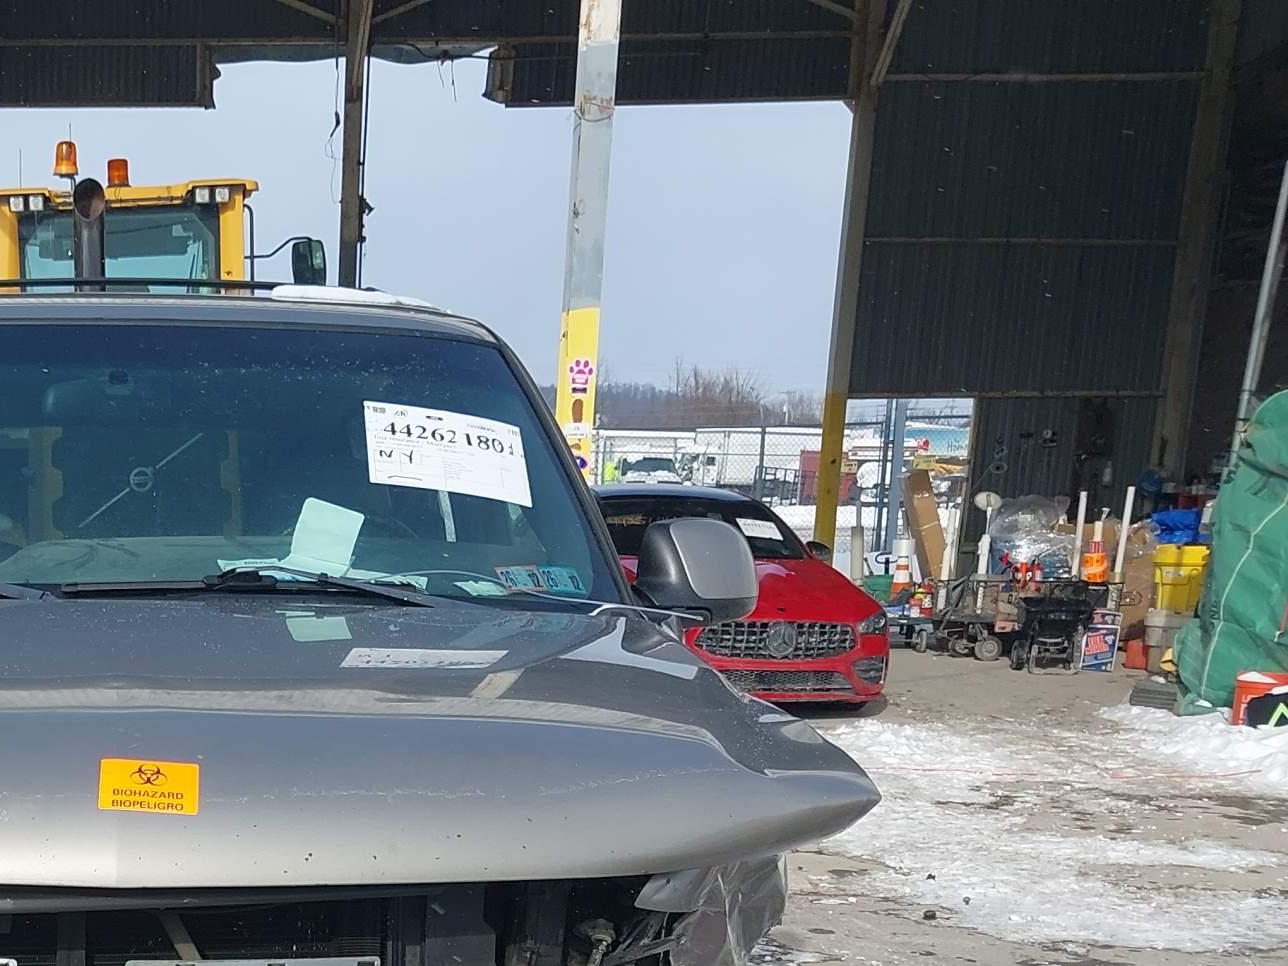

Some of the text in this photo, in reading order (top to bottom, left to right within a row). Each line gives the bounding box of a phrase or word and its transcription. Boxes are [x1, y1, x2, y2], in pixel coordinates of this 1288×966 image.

[528, 572, 545, 588] 12
[112, 788, 184, 800] BIOHAZARD
[111, 799, 184, 811] BIOPELIGRO
